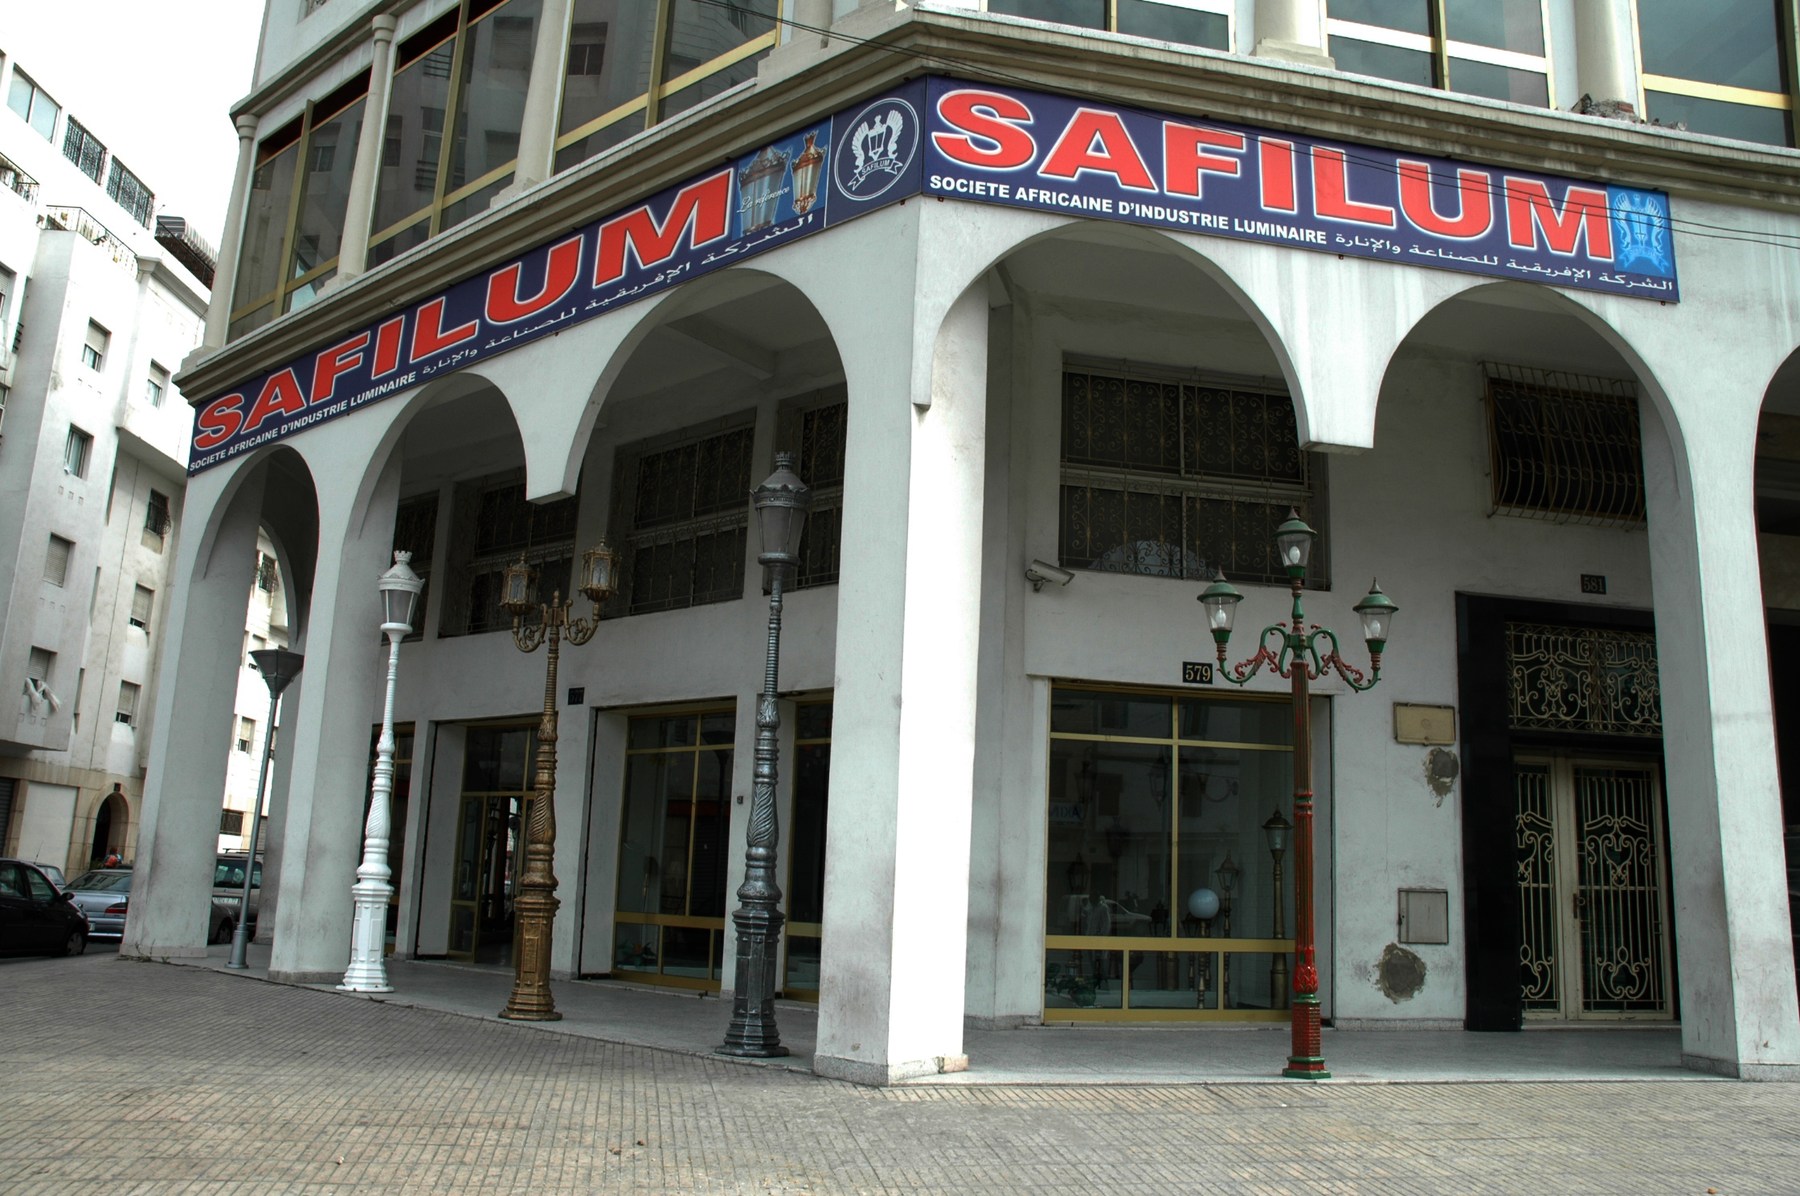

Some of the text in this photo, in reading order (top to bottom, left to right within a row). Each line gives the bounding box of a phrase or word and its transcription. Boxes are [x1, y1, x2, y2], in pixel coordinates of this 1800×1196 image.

[861, 159, 890, 175] SAFILUM
[931, 89, 1614, 262] SAFILUM
[930, 175, 1327, 245] SOCIETE AFRICAINE D'INDUSTRIE LUMINAIRE
[423, 213, 813, 374] الشركة الإفريقية للصناعة والإنارة
[1335, 233, 1673, 291] الشركة الإفريقية للصناعة والإنارة
[193, 167, 734, 450] SAFILUM
[190, 371, 416, 471] SOCIETE AFRICAINE D'INDUSTRIE LUMINAIRE
[1583, 577, 1605, 592] 581
[1185, 664, 1211, 681] 579
